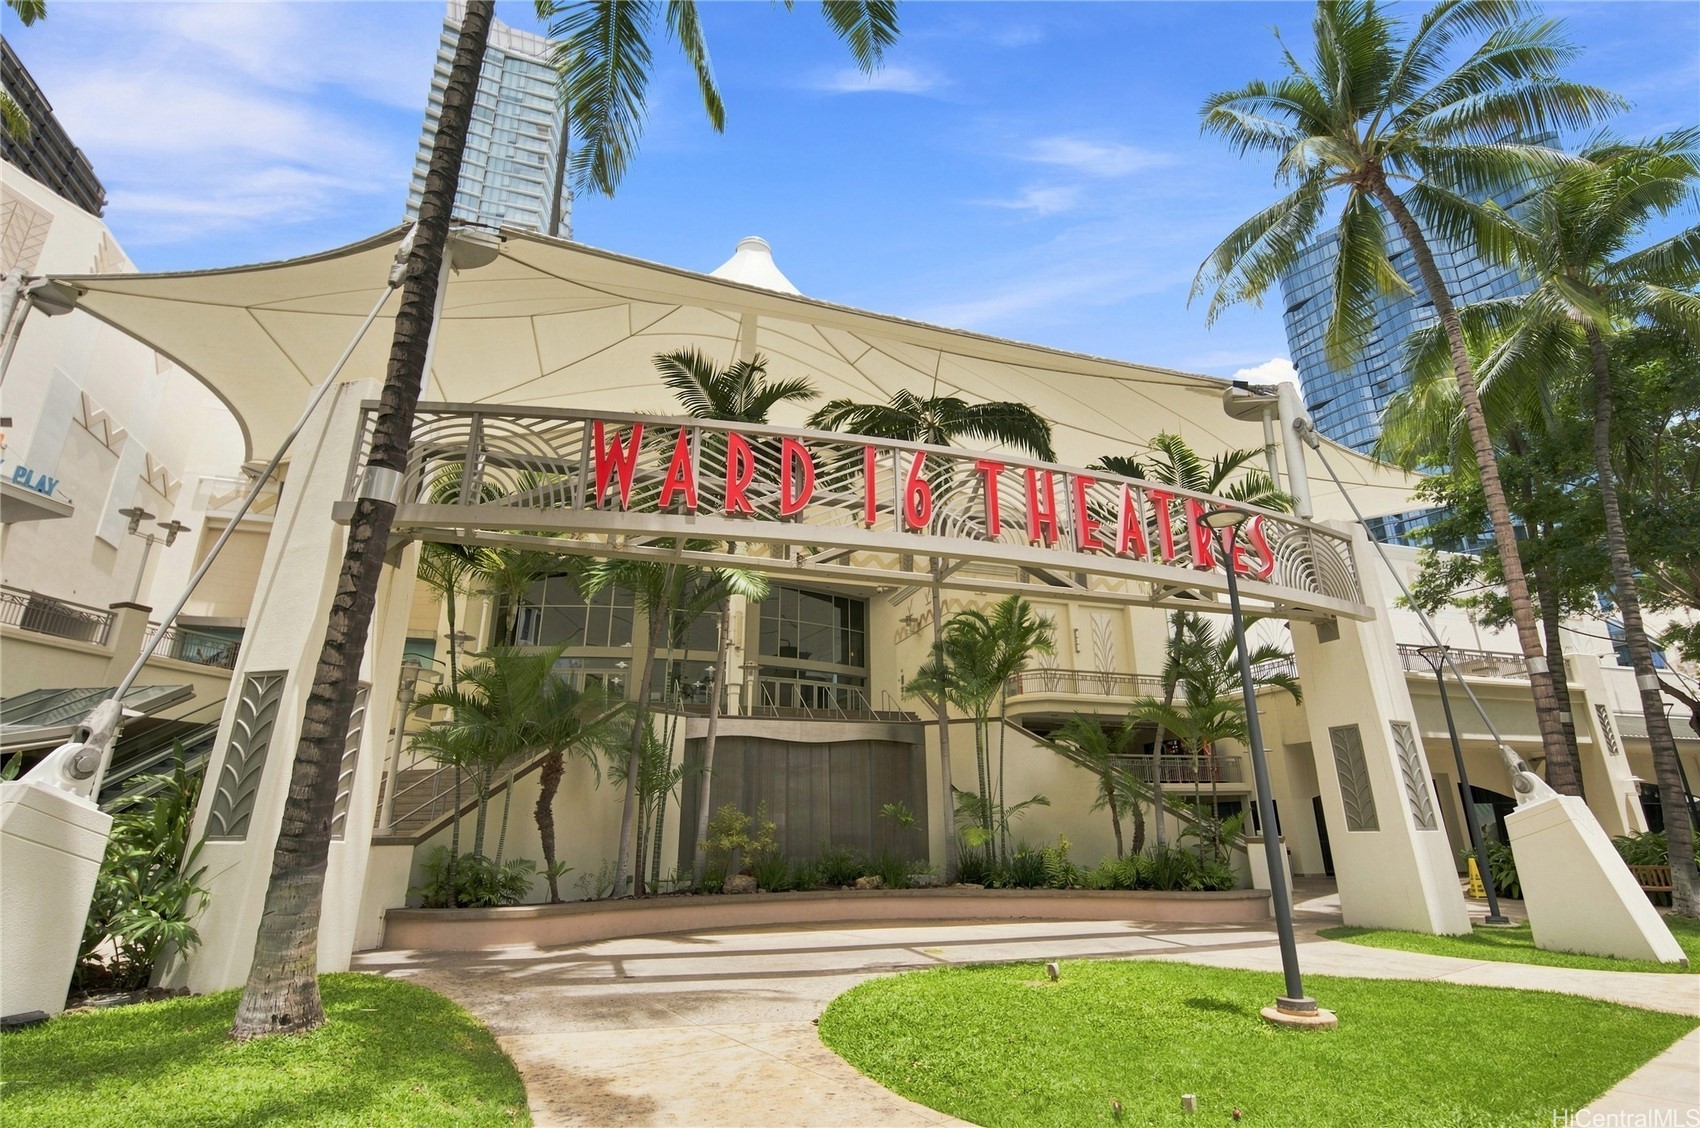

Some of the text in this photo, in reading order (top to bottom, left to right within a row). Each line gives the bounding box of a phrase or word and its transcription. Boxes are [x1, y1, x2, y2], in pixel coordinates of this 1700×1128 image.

[12, 465, 59, 496] PLAY
[592, 420, 1276, 581] WARD 16 THEATRES
